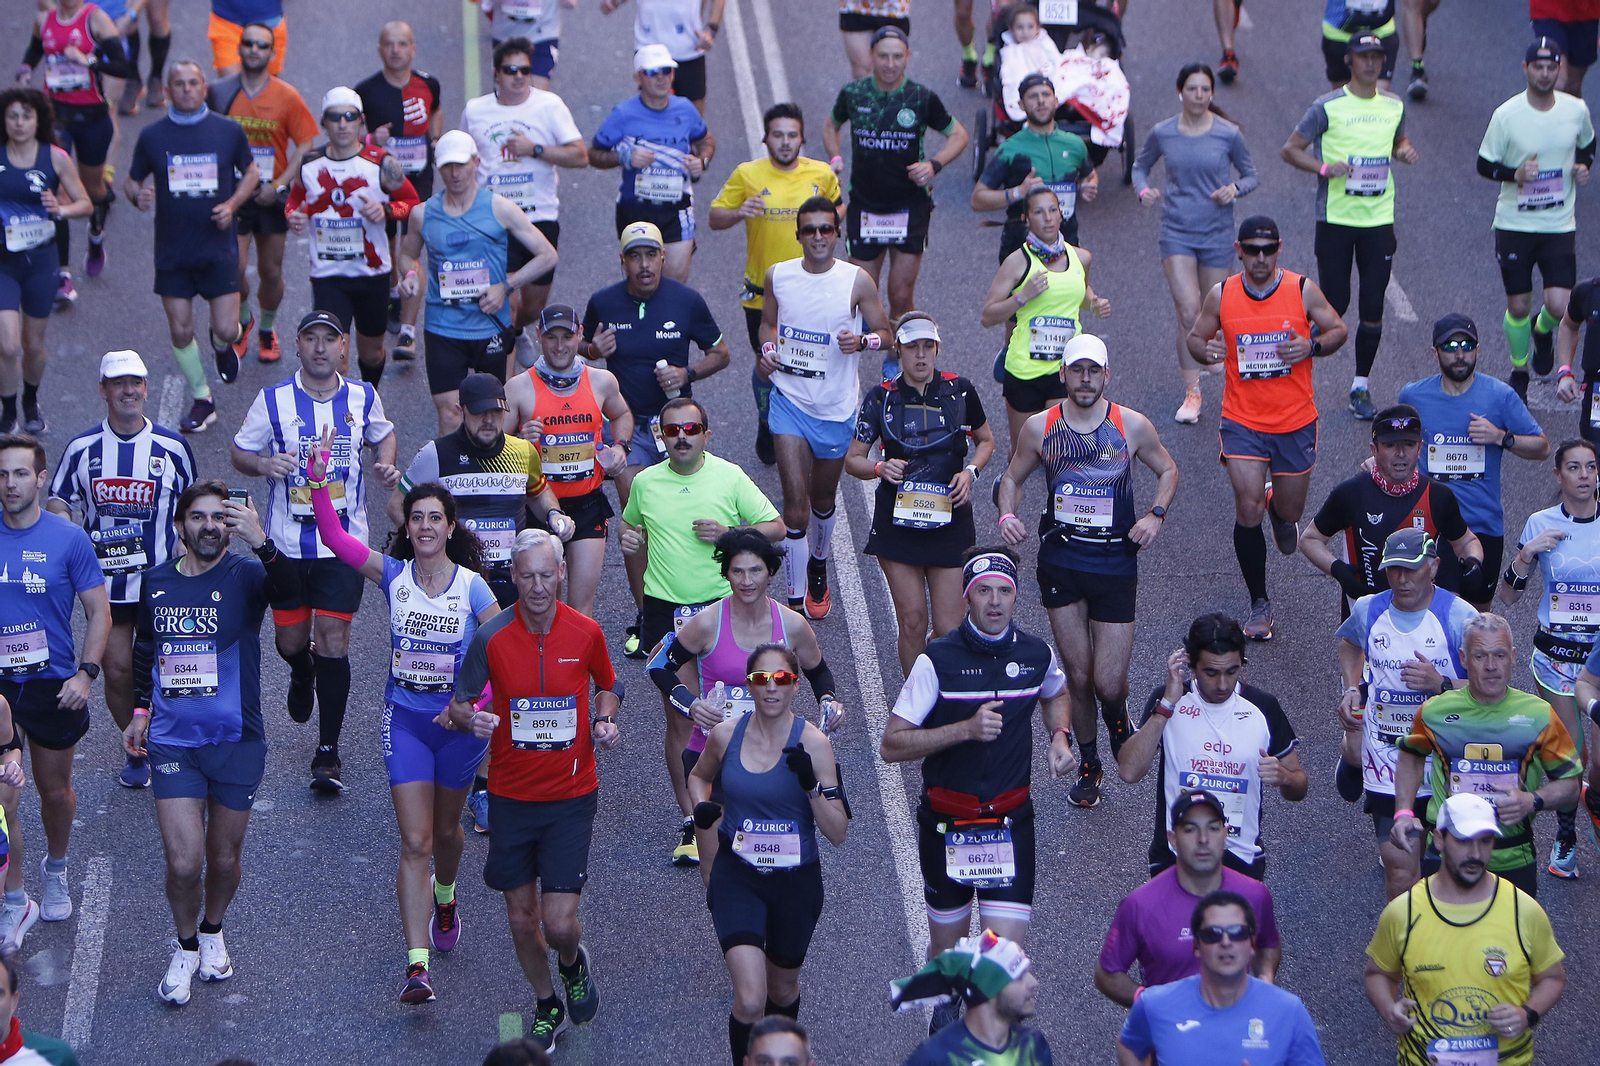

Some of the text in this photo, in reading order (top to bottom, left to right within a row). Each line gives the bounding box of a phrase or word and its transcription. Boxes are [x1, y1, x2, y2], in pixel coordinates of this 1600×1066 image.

[1044, 3, 1070, 19] 8521
[397, 138, 423, 146] ZURICH
[858, 137, 910, 150] MONTIJO
[183, 155, 211, 164] ZURICH
[500, 175, 528, 183] ZURICH
[330, 219, 357, 227] ZURICH
[453, 261, 484, 271] ZURICH
[455, 277, 475, 286] 6644
[1045, 319, 1071, 328] ZURICH
[794, 330, 824, 342] ZURICH
[1253, 334, 1284, 343] ZURICH
[789, 347, 814, 358] 11646
[1254, 351, 1276, 360] 7725
[543, 413, 593, 427] CARRERA
[557, 434, 589, 444] ZURICH
[1446, 436, 1472, 444] ZURIC
[558, 452, 581, 462] 3677
[1445, 452, 1468, 461] 8678
[1445, 464, 1467, 472] ISIDRO
[914, 483, 945, 494] ZURICH
[1074, 486, 1106, 497] ZURICH
[912, 499, 935, 510] 5526
[1072, 504, 1096, 515] 7585
[911, 511, 933, 520] MYMY
[1074, 515, 1092, 525] ENAK
[478, 522, 509, 532] ZURICH
[101, 527, 135, 540] ZURICH
[484, 539, 501, 549] 050
[105, 545, 129, 556] 1849
[104, 558, 131, 568] TXABUS
[25, 586, 46, 594] 2019
[154, 605, 218, 617] COMPUTER
[1568, 602, 1593, 612] 8315
[407, 610, 460, 626] PODISTICA
[1570, 614, 1589, 622] JANA
[2, 621, 37, 634] ZURICH
[153, 615, 218, 634] GROSS
[404, 618, 459, 634] EMPOLESE
[403, 626, 428, 638] 1986
[5, 642, 30, 653] 7626
[173, 643, 209, 654] ZURICH
[412, 641, 447, 654] ZURICH
[9, 655, 28, 665] PAUL
[174, 663, 198, 674] 6344
[410, 660, 435, 672] 8298
[171, 677, 202, 686] CRISTIAN
[398, 671, 446, 682] PILAR VARGAS
[1392, 694, 1428, 703] ZURICH
[531, 699, 569, 710] ZURICH
[1179, 705, 1200, 719] edp
[1390, 712, 1414, 723] 1063
[530, 719, 557, 729] 8976
[1378, 723, 1405, 734] MANUEL
[534, 732, 553, 740] WILL
[1203, 740, 1232, 756] edp
[1473, 763, 1511, 773] ZURICH
[1201, 778, 1240, 790] ZURICH
[1472, 783, 1497, 792] 748
[754, 822, 792, 832] ZURICH
[967, 832, 1005, 844] ZURICH
[753, 843, 781, 853] 8548
[756, 856, 775, 865] AURI
[967, 853, 995, 864] 6672
[959, 865, 1003, 877] R. ALMIRÓN
[1450, 1038, 1492, 1050] ZURICH
